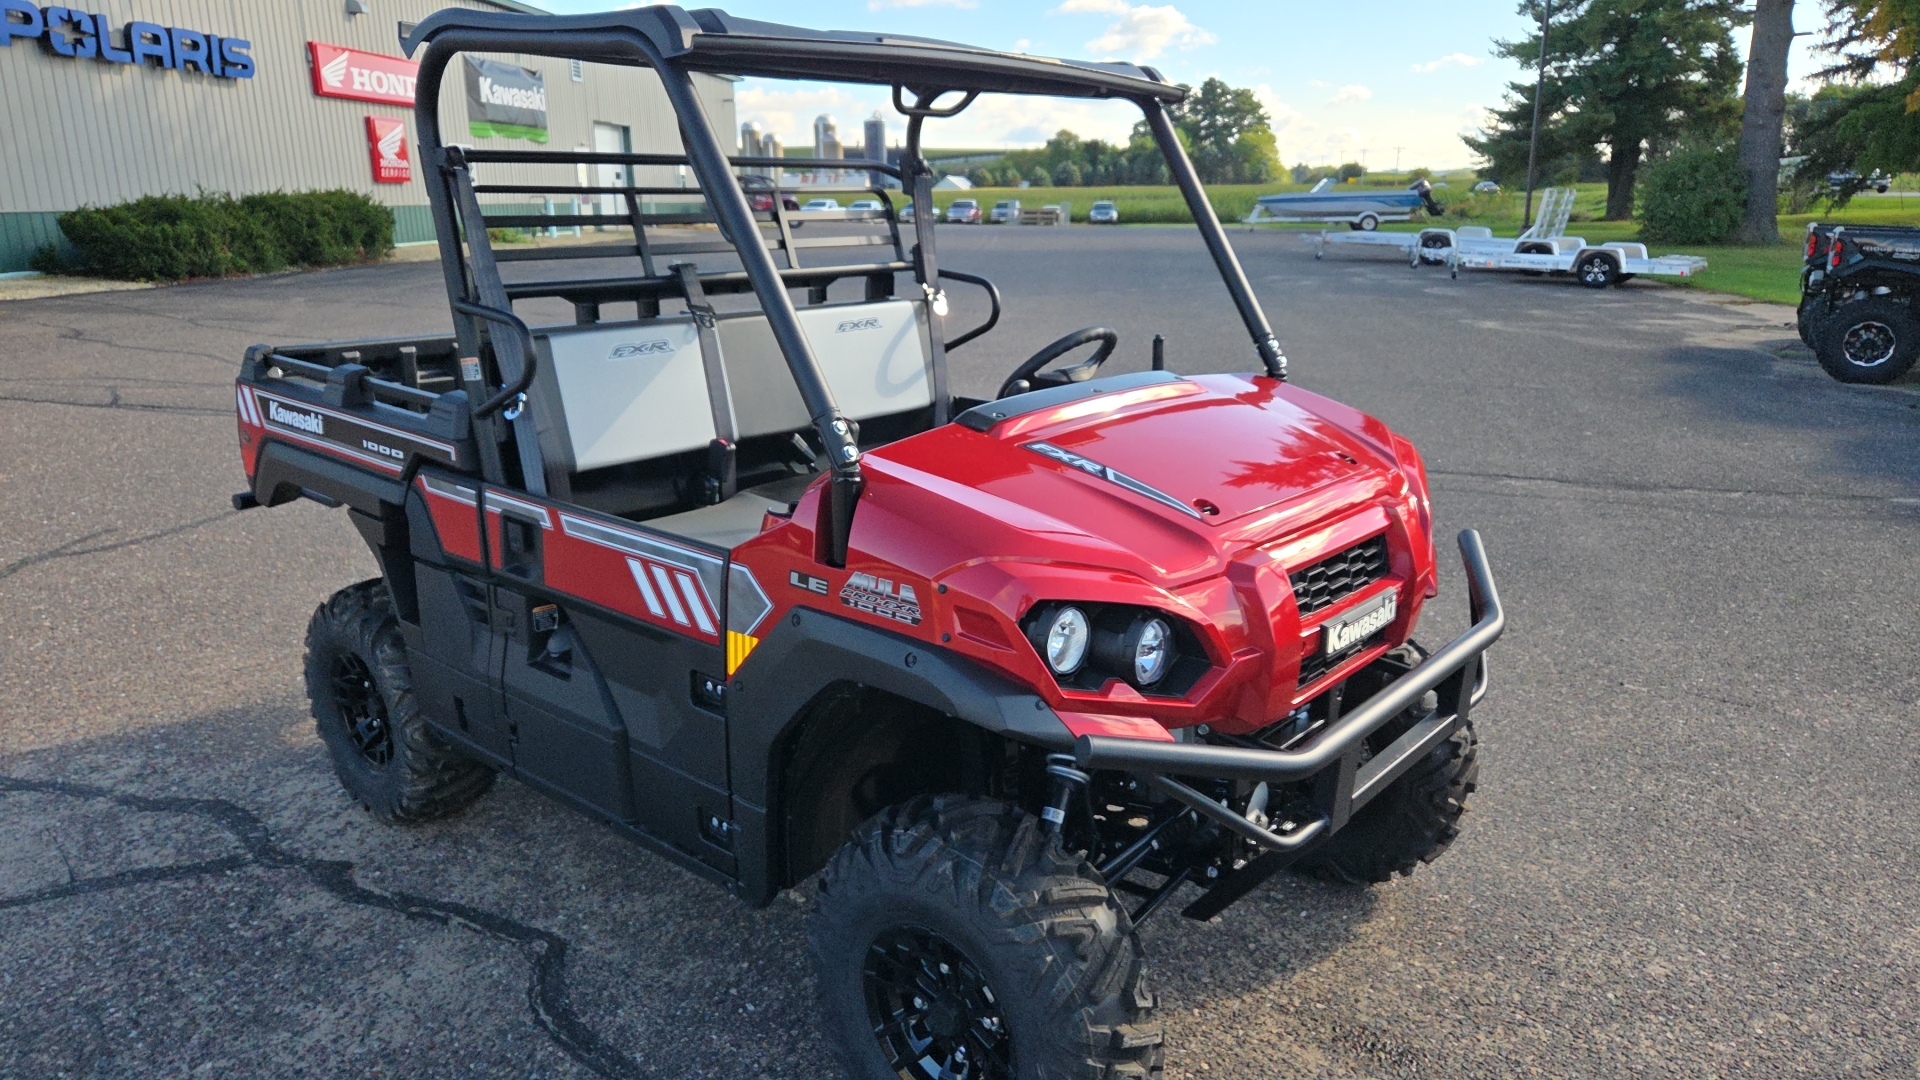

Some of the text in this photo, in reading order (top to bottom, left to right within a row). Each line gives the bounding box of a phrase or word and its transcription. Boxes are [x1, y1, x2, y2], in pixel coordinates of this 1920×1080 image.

[0, 0, 255, 79] POLARIS
[350, 67, 417, 98] HOND
[478, 76, 546, 112] Kawasaki
[269, 400, 324, 435] Kawasaki
[362, 439, 404, 459] 1000
[1026, 443, 1104, 476] FXR
[790, 571, 828, 595] LE
[844, 571, 919, 606] MULE
[1327, 594, 1397, 654] Kawasaki
